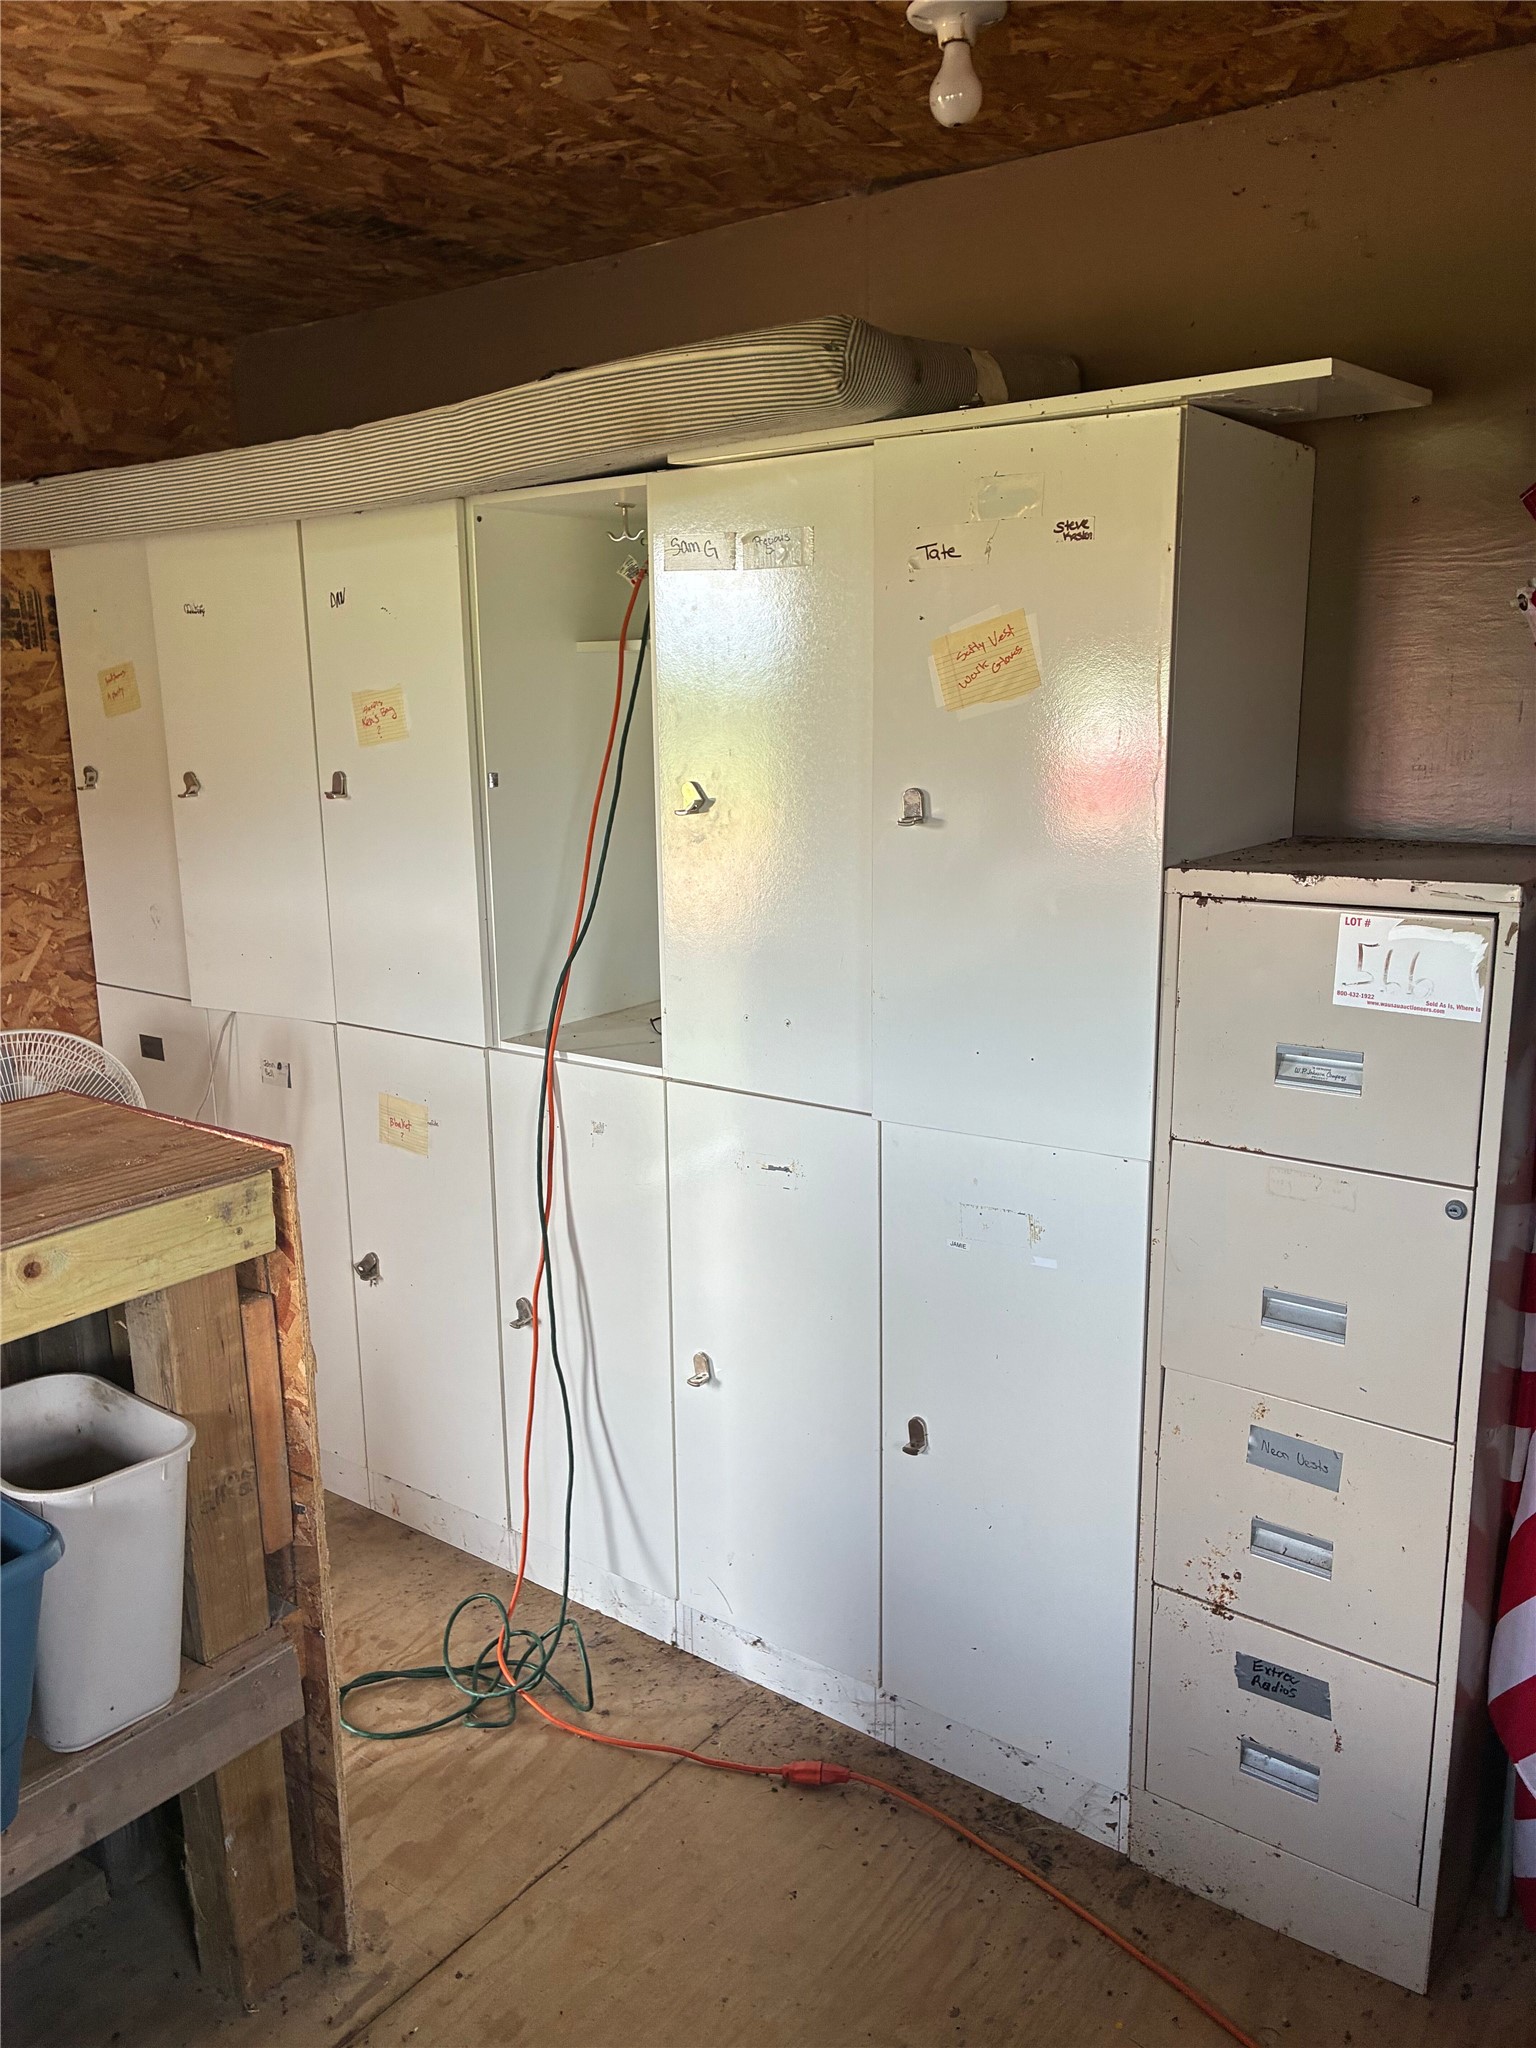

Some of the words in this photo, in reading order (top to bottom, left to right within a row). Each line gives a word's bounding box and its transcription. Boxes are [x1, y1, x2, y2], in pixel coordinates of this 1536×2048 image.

[1053, 519, 1090, 533] Steve
[670, 537, 701, 556] Sam
[703, 539, 720, 560] G
[915, 542, 962, 561] Tate
[987, 623, 1015, 647] Vest
[1344, 917, 1363, 926] LOT
[1364, 918, 1372, 928] #
[1336, 990, 1375, 1000] 800-432-1922
[1366, 1000, 1446, 1014] www.wausauauctioneers.com
[1425, 1000, 1438, 1008] Sold
[1456, 1004, 1474, 1012] Where
[1261, 1439, 1290, 1461] Neon
[1252, 1659, 1301, 1685] Extra
[1250, 1674, 1298, 1698] Radios
